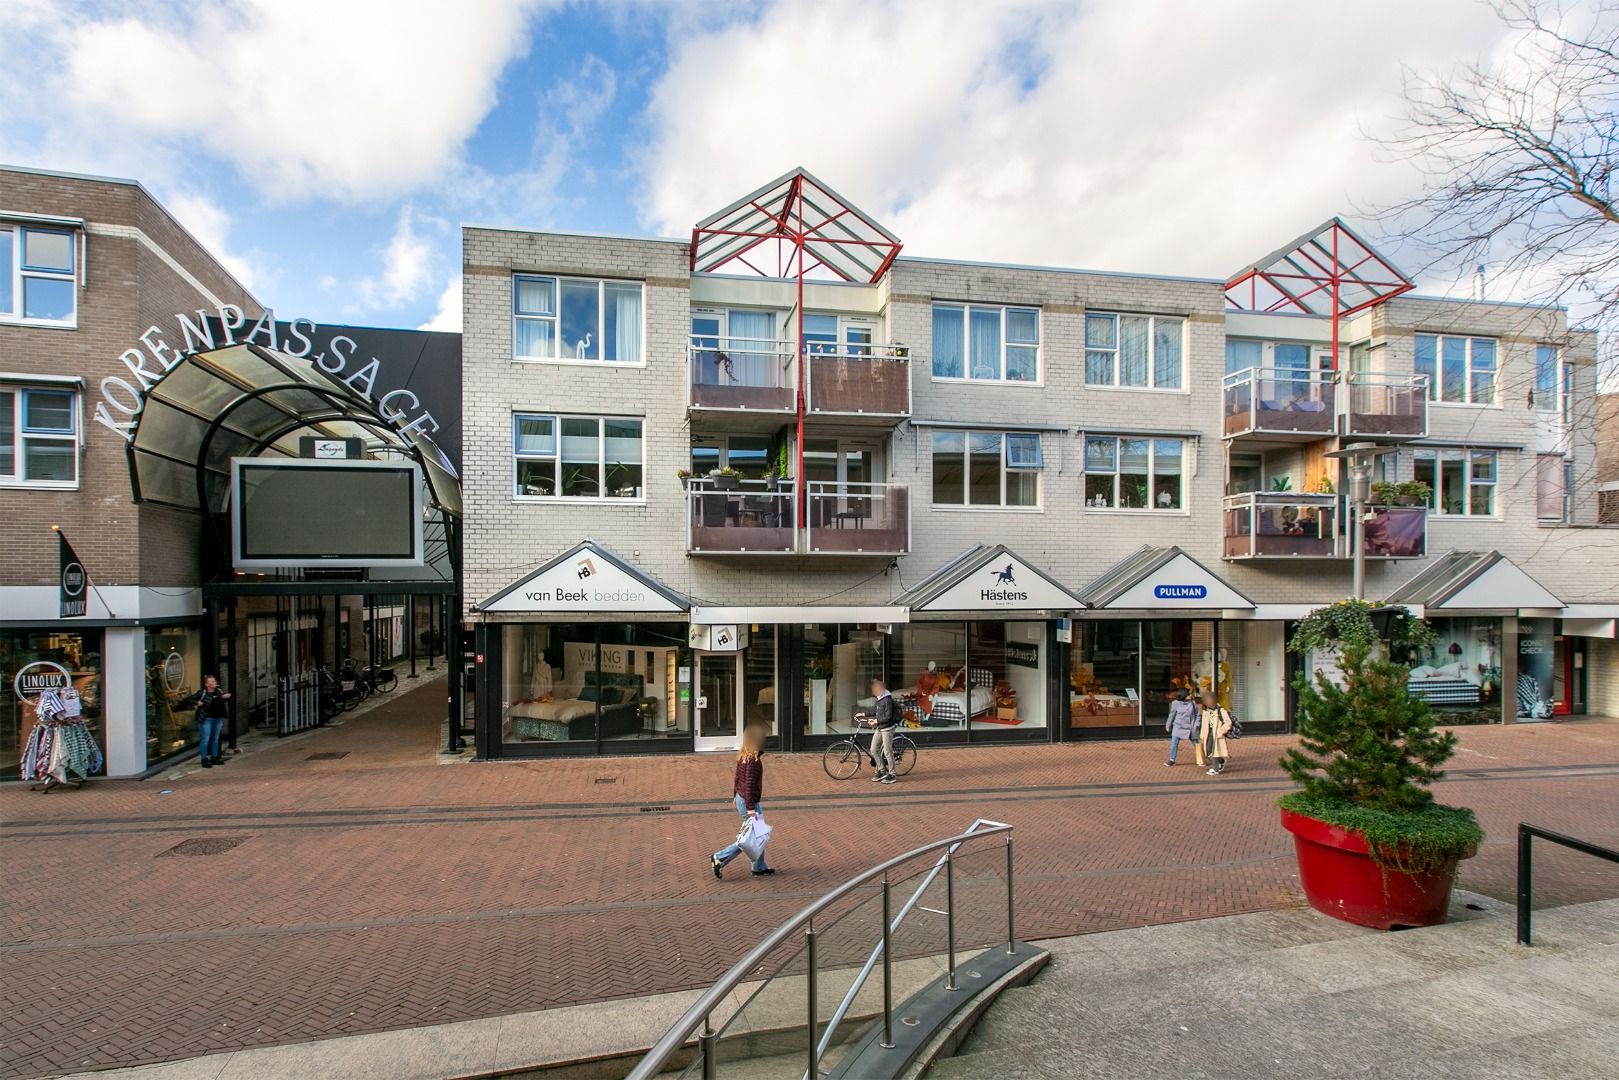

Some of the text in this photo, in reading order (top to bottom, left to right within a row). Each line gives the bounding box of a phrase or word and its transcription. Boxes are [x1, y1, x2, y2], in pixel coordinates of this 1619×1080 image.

[93, 303, 439, 449] KORENPASSAGE
[525, 588, 645, 602] van Beek bedden
[981, 589, 1028, 601] Hästens
[1160, 587, 1202, 597] PULLMAN
[60, 600, 86, 616] LINOLUX
[22, 674, 62, 688] LINOLUX
